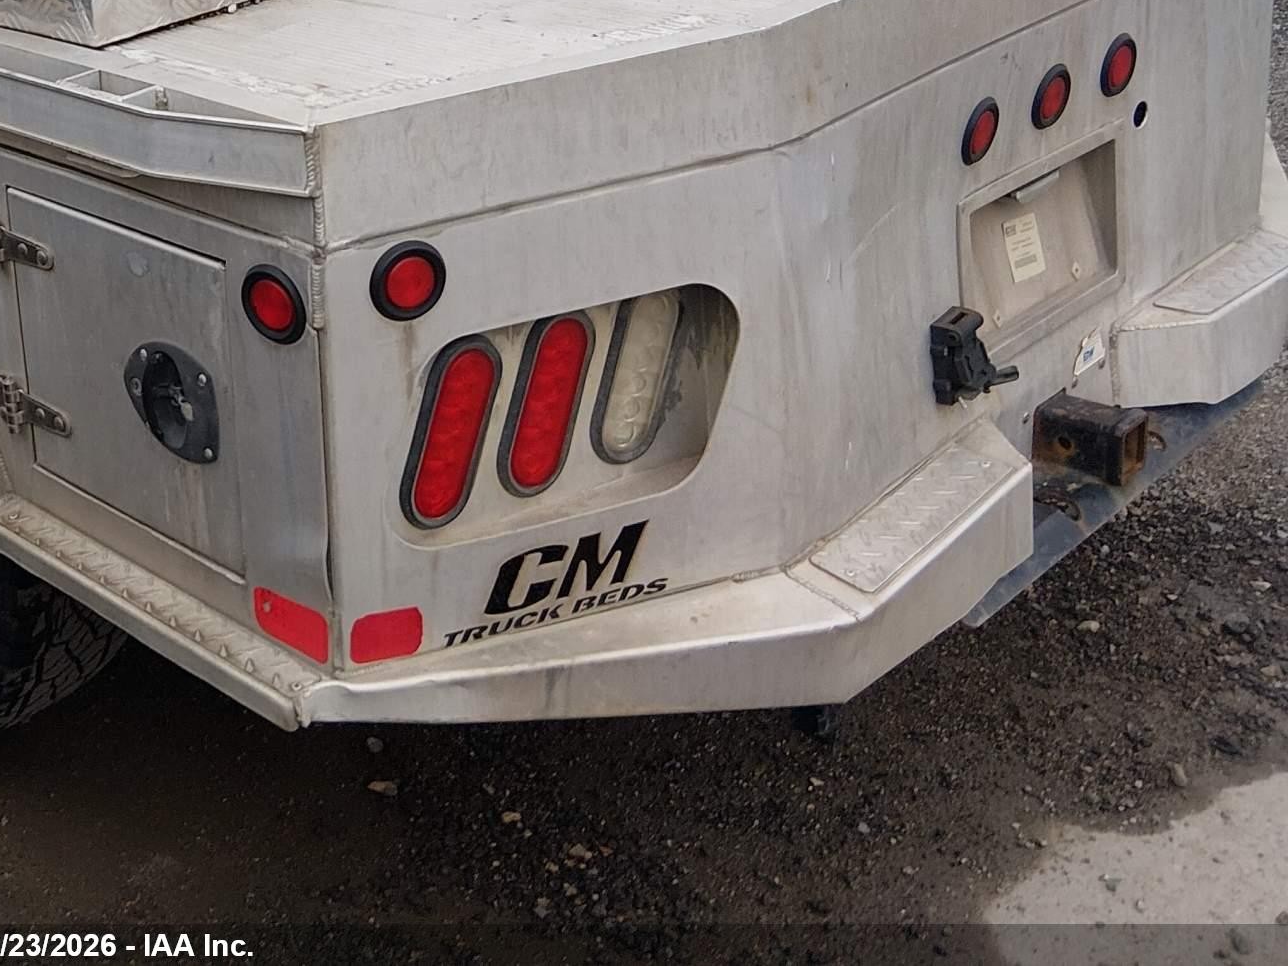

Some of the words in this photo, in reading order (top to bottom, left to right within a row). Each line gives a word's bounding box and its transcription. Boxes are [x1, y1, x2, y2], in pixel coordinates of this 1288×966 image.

[483, 519, 650, 615] CM
[443, 603, 566, 648] TRUCK
[571, 577, 669, 614] BEDS
